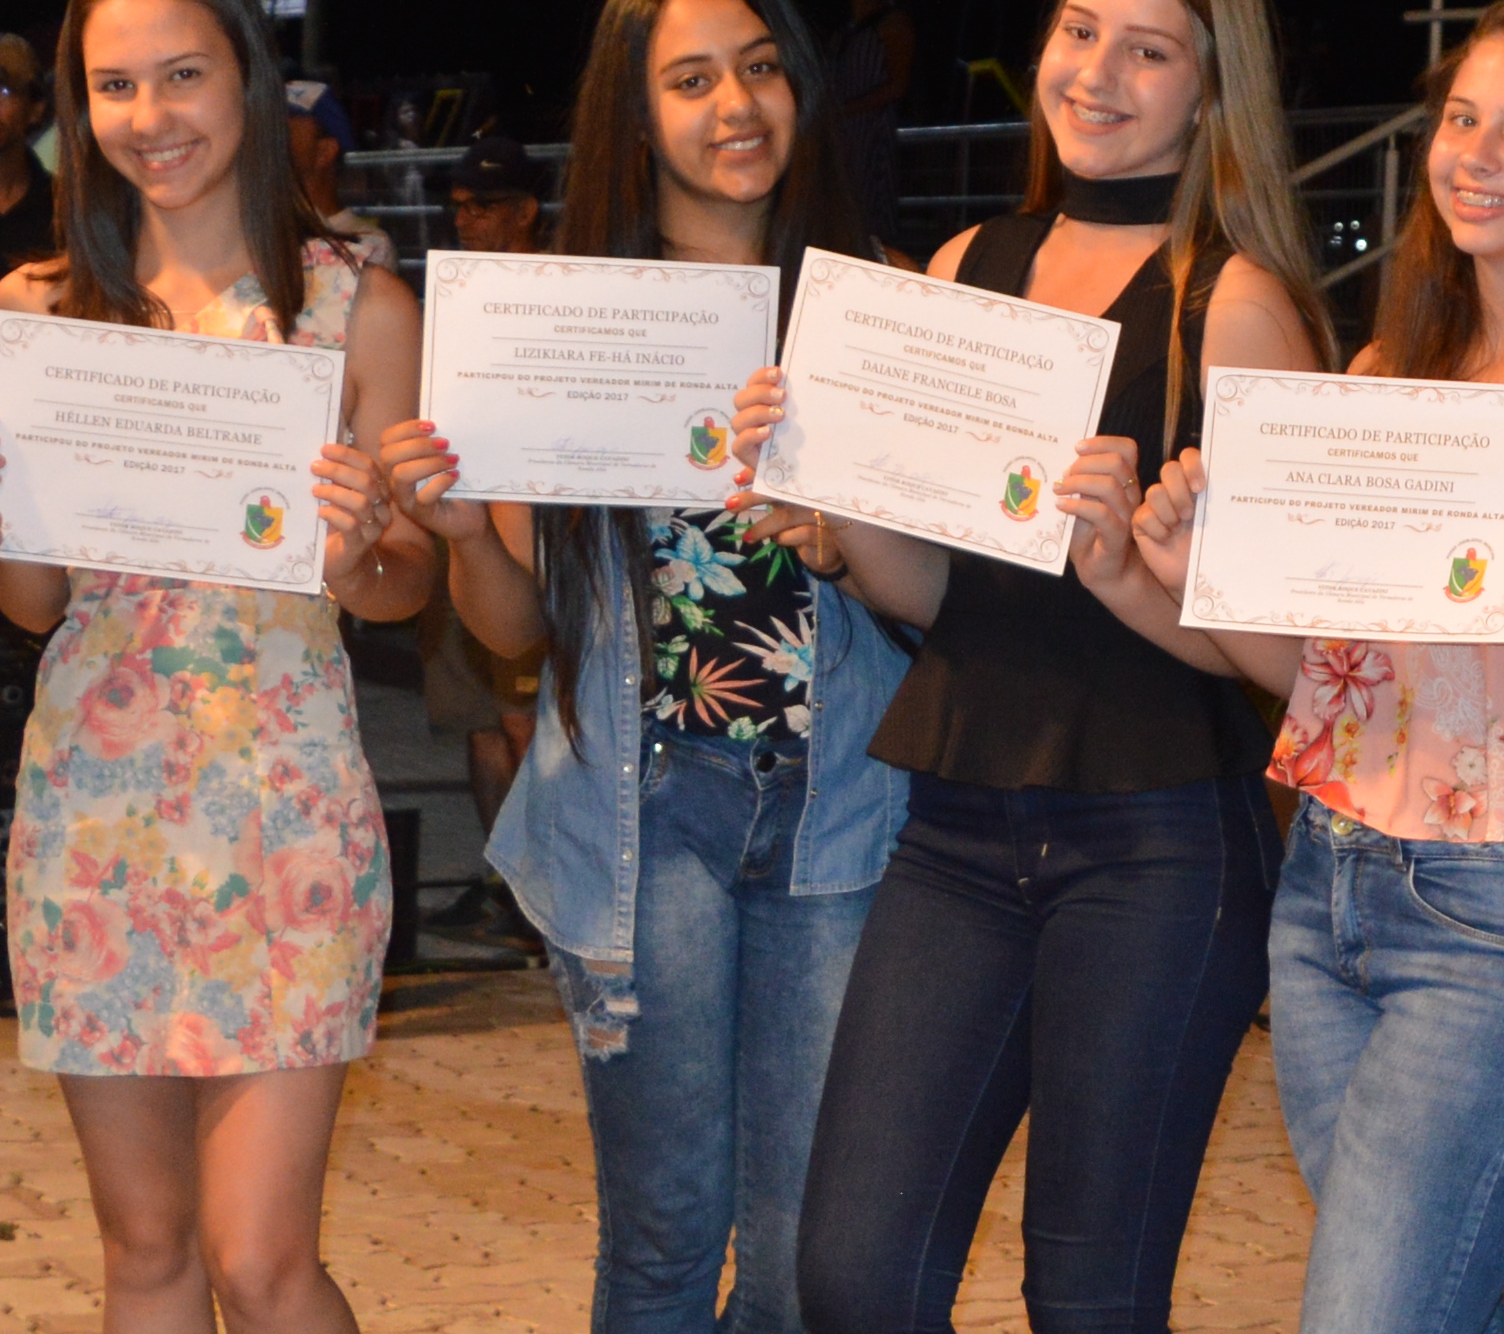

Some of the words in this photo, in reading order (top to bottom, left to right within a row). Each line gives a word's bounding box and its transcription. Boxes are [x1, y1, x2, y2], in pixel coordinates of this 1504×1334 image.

[482, 302, 584, 318] CERTIFICADO
[587, 306, 608, 319] DE
[611, 307, 719, 327] PARTICIPAÇÃO
[553, 324, 625, 337] CERTIFICAMOS
[627, 328, 647, 338] QUE
[844, 309, 934, 341] CERTIFICADO
[936, 331, 955, 347] DE
[957, 337, 1054, 372] PARTICIPAÇÃO
[514, 346, 585, 362] LIZIKIARA
[903, 344, 967, 368] CERTIFICAMOS
[968, 360, 986, 373] QUE
[861, 359, 910, 381] DAIANE
[912, 372, 983, 400] FRANCIELE
[984, 390, 1017, 409] BOSA
[566, 390, 602, 402] EDIÇÃO
[603, 392, 629, 402] 2017
[903, 412, 935, 428] EDIÇÃO
[935, 421, 959, 435] 2017
[1259, 422, 1358, 441] CERTIFICADO
[1361, 428, 1382, 442] DE
[1385, 430, 1491, 450] PARTICIPAÇÃO
[1327, 448, 1397, 461] CERTIFICAMOS
[1399, 452, 1418, 463] QUE
[1286, 471, 1314, 484] ANA
[1317, 473, 1362, 487] CLARA
[1365, 475, 1401, 490] BOSA
[1404, 478, 1454, 494] GADINI
[1230, 495, 1286, 506] PARTICIPOU
[1288, 499, 1302, 507] DO
[1304, 500, 1346, 510] PROJETO
[1349, 504, 1398, 514] VEREADOR
[1400, 507, 1429, 516] MIRIM
[1431, 509, 1444, 517] DE
[1446, 510, 1479, 519] RONDA
[1334, 517, 1369, 530] EDIÇÃO
[1370, 520, 1396, 530] 2017
